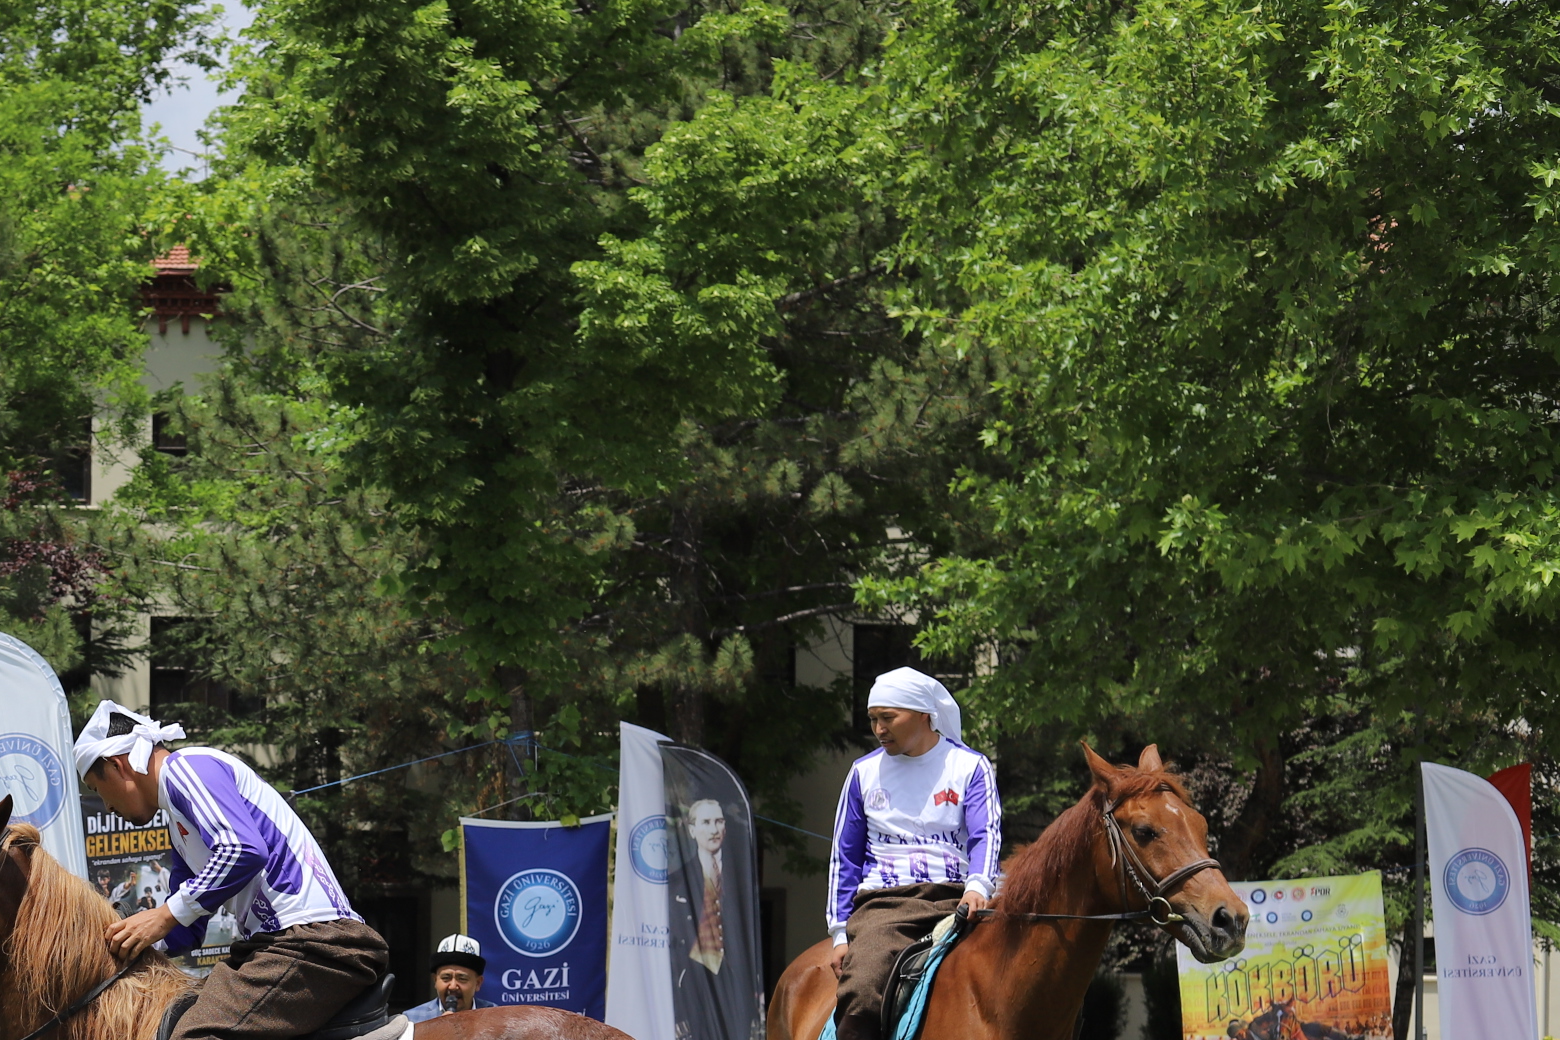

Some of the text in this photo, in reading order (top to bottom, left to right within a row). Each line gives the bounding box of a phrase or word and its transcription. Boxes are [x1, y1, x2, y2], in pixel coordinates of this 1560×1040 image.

[87, 808, 170, 834] DİJİTAEN
[85, 828, 173, 858] GELENEKSEL
[500, 874, 577, 918] GAZİ ÜNİVERSİTESİ
[525, 938, 551, 951] 1926
[501, 962, 571, 990] GAZİ
[1206, 933, 1366, 1024] KÖKBÖRÜ
[501, 989, 570, 1003] ÜNİVERSİTESİ
